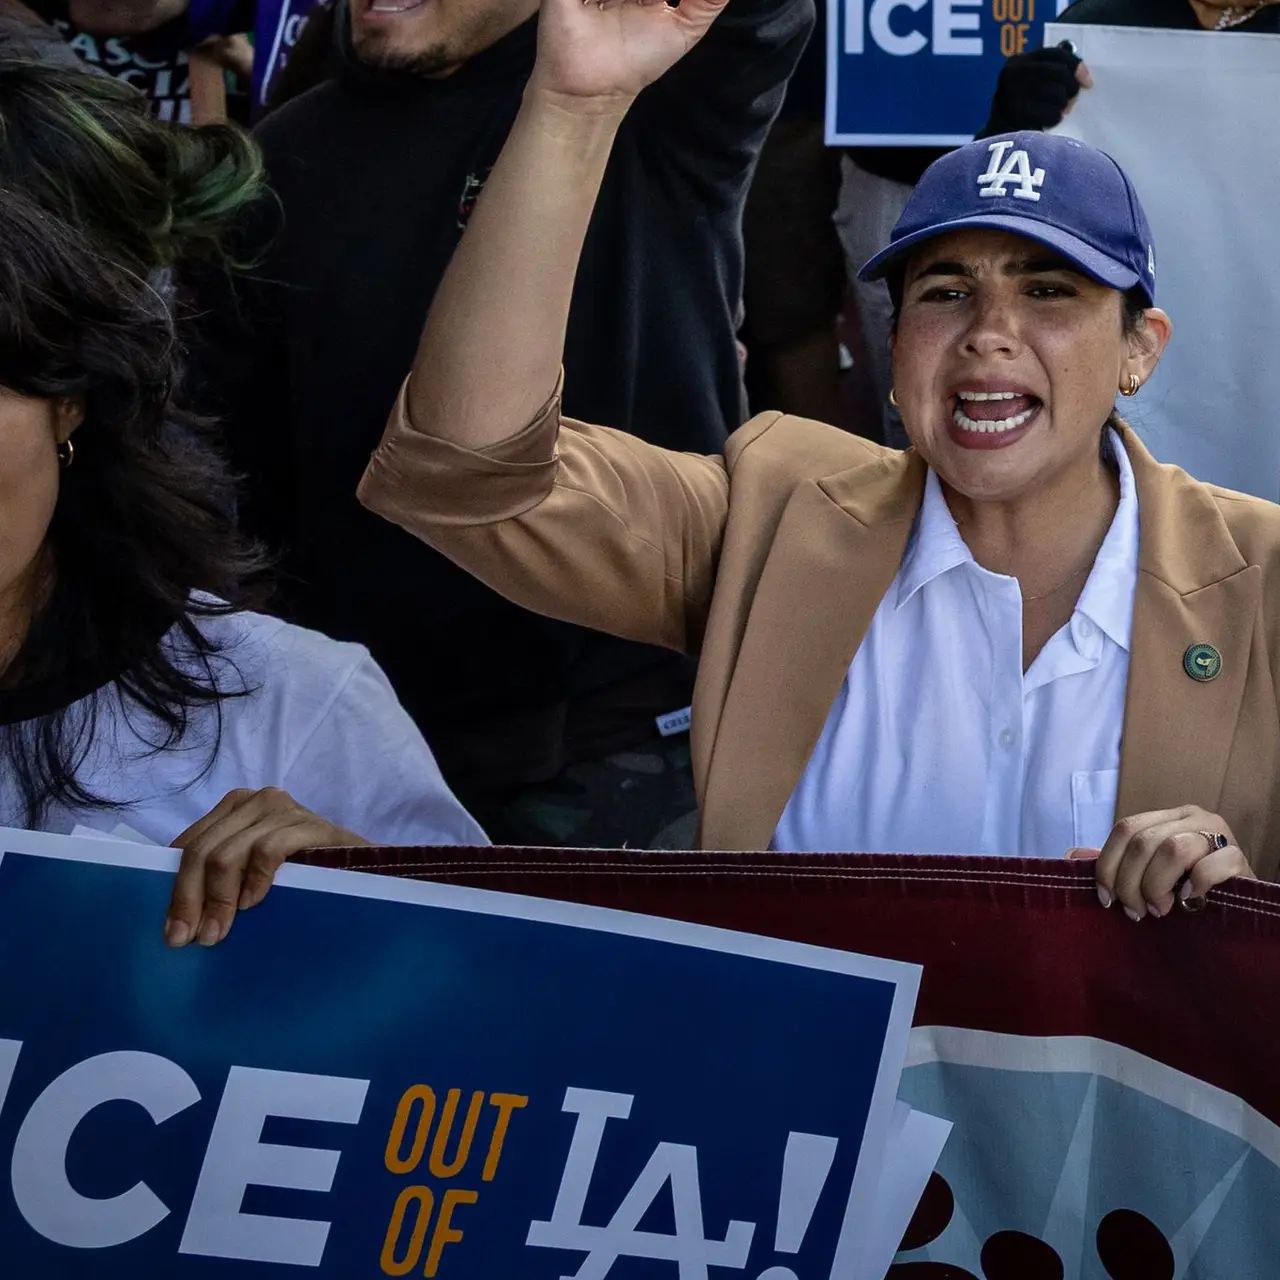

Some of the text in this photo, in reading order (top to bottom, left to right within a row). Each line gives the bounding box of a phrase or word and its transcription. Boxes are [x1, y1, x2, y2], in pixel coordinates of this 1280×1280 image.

[1000, 22, 1030, 58] OF
[976, 140, 1046, 201] LA
[0, 1036, 372, 1268] CE
[383, 1083, 529, 1182] OUT
[379, 1185, 480, 1279] OF
